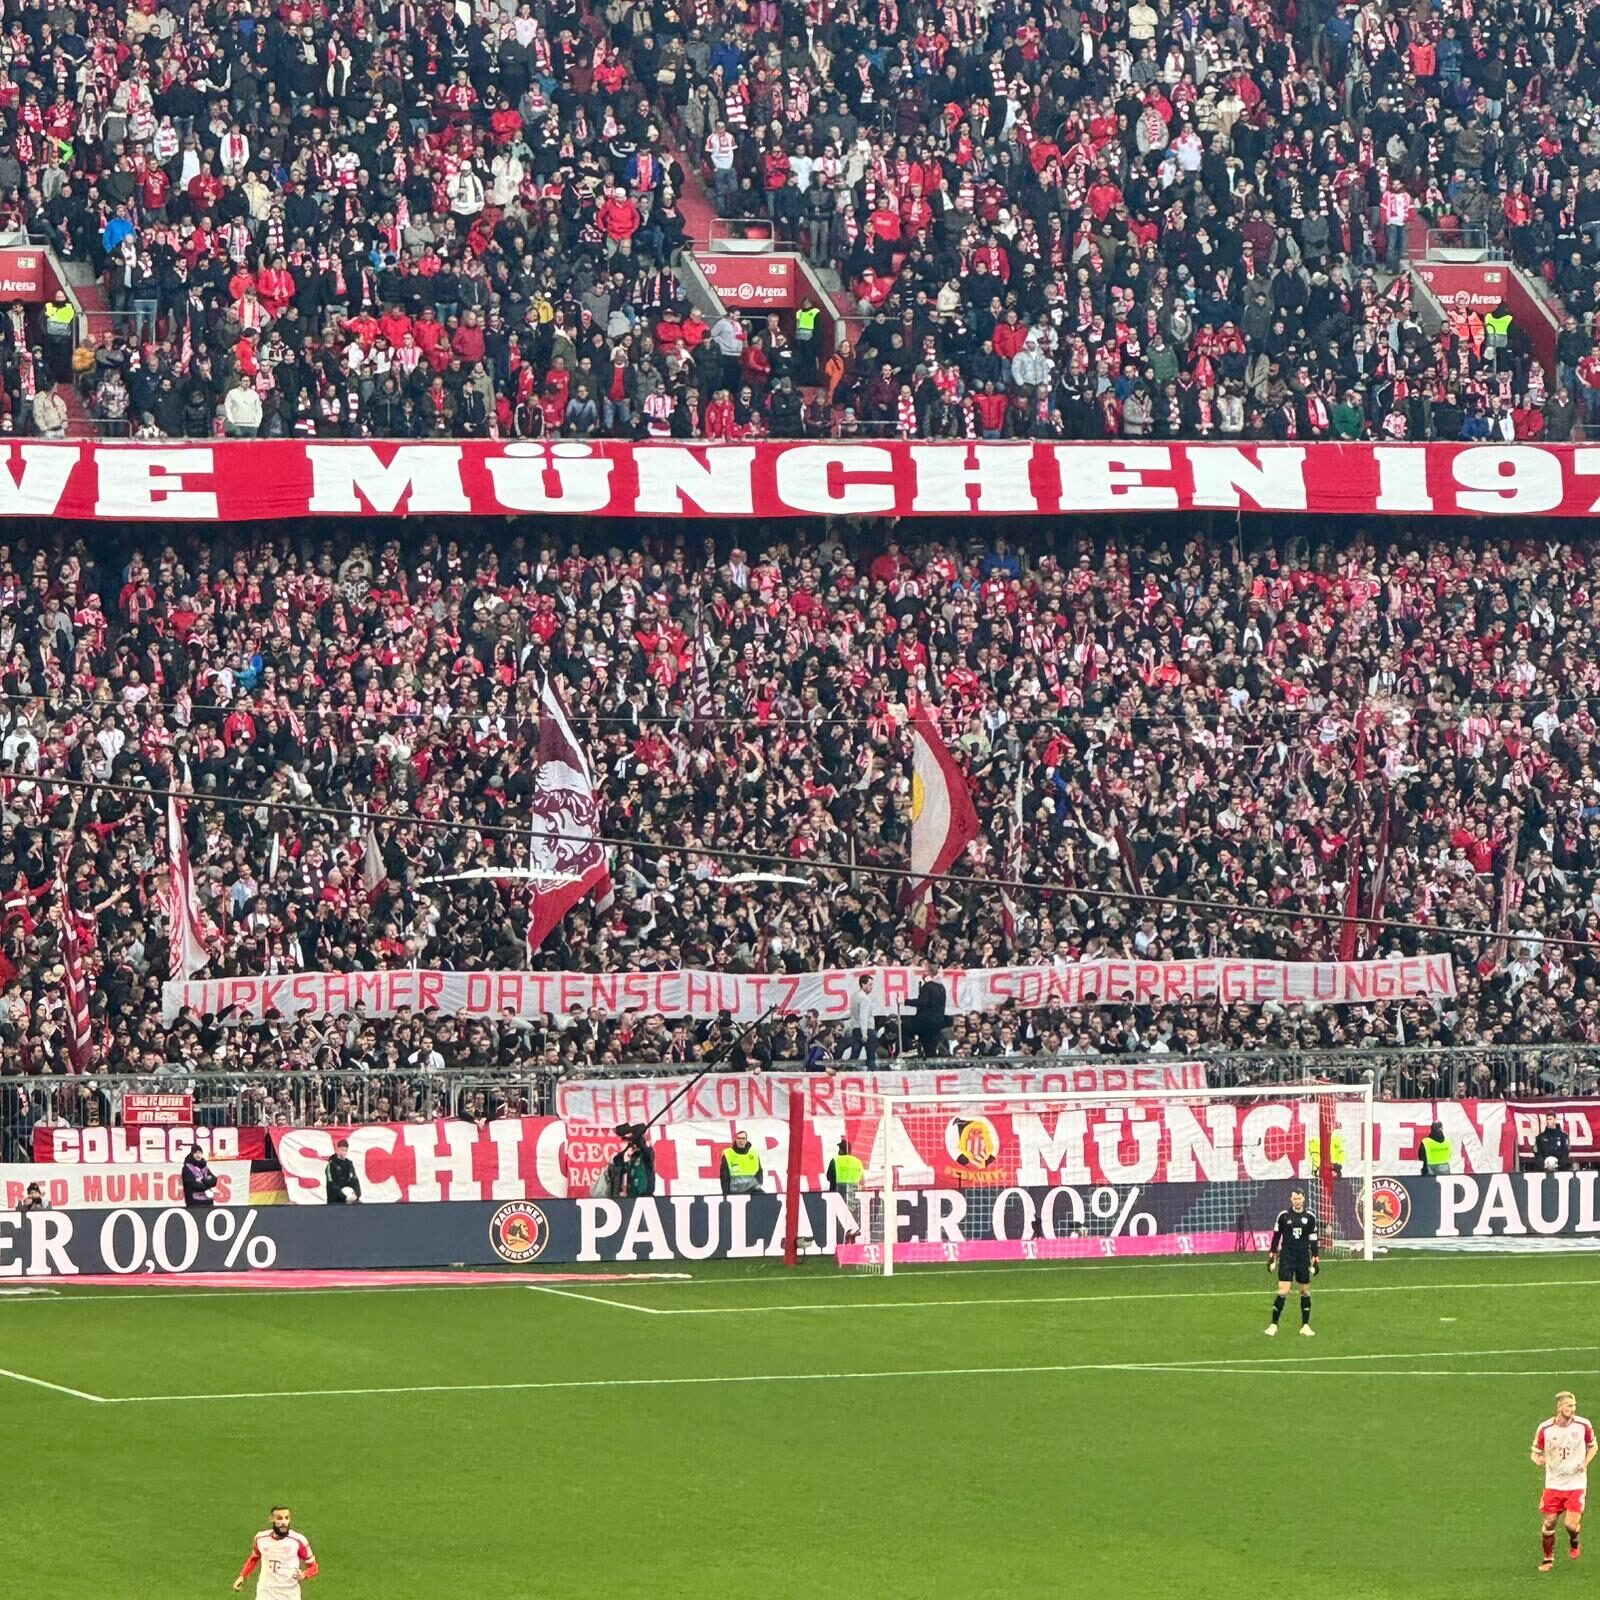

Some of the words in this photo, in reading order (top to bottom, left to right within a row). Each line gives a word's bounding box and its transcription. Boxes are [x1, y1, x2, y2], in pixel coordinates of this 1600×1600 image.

[2, 280, 36, 291] Arena
[755, 285, 787, 296] Arena
[1471, 293, 1501, 304] Arena
[305, 442, 1306, 515] MÜNCHEN
[1374, 446, 1600, 514] 19
[183, 971, 443, 1021] WIRKSAMER
[467, 971, 799, 1015] DATENSCHUTZ
[989, 955, 1449, 1007] SONDERREGELUNGEN
[100, 1207, 277, 1274] 0,0%
